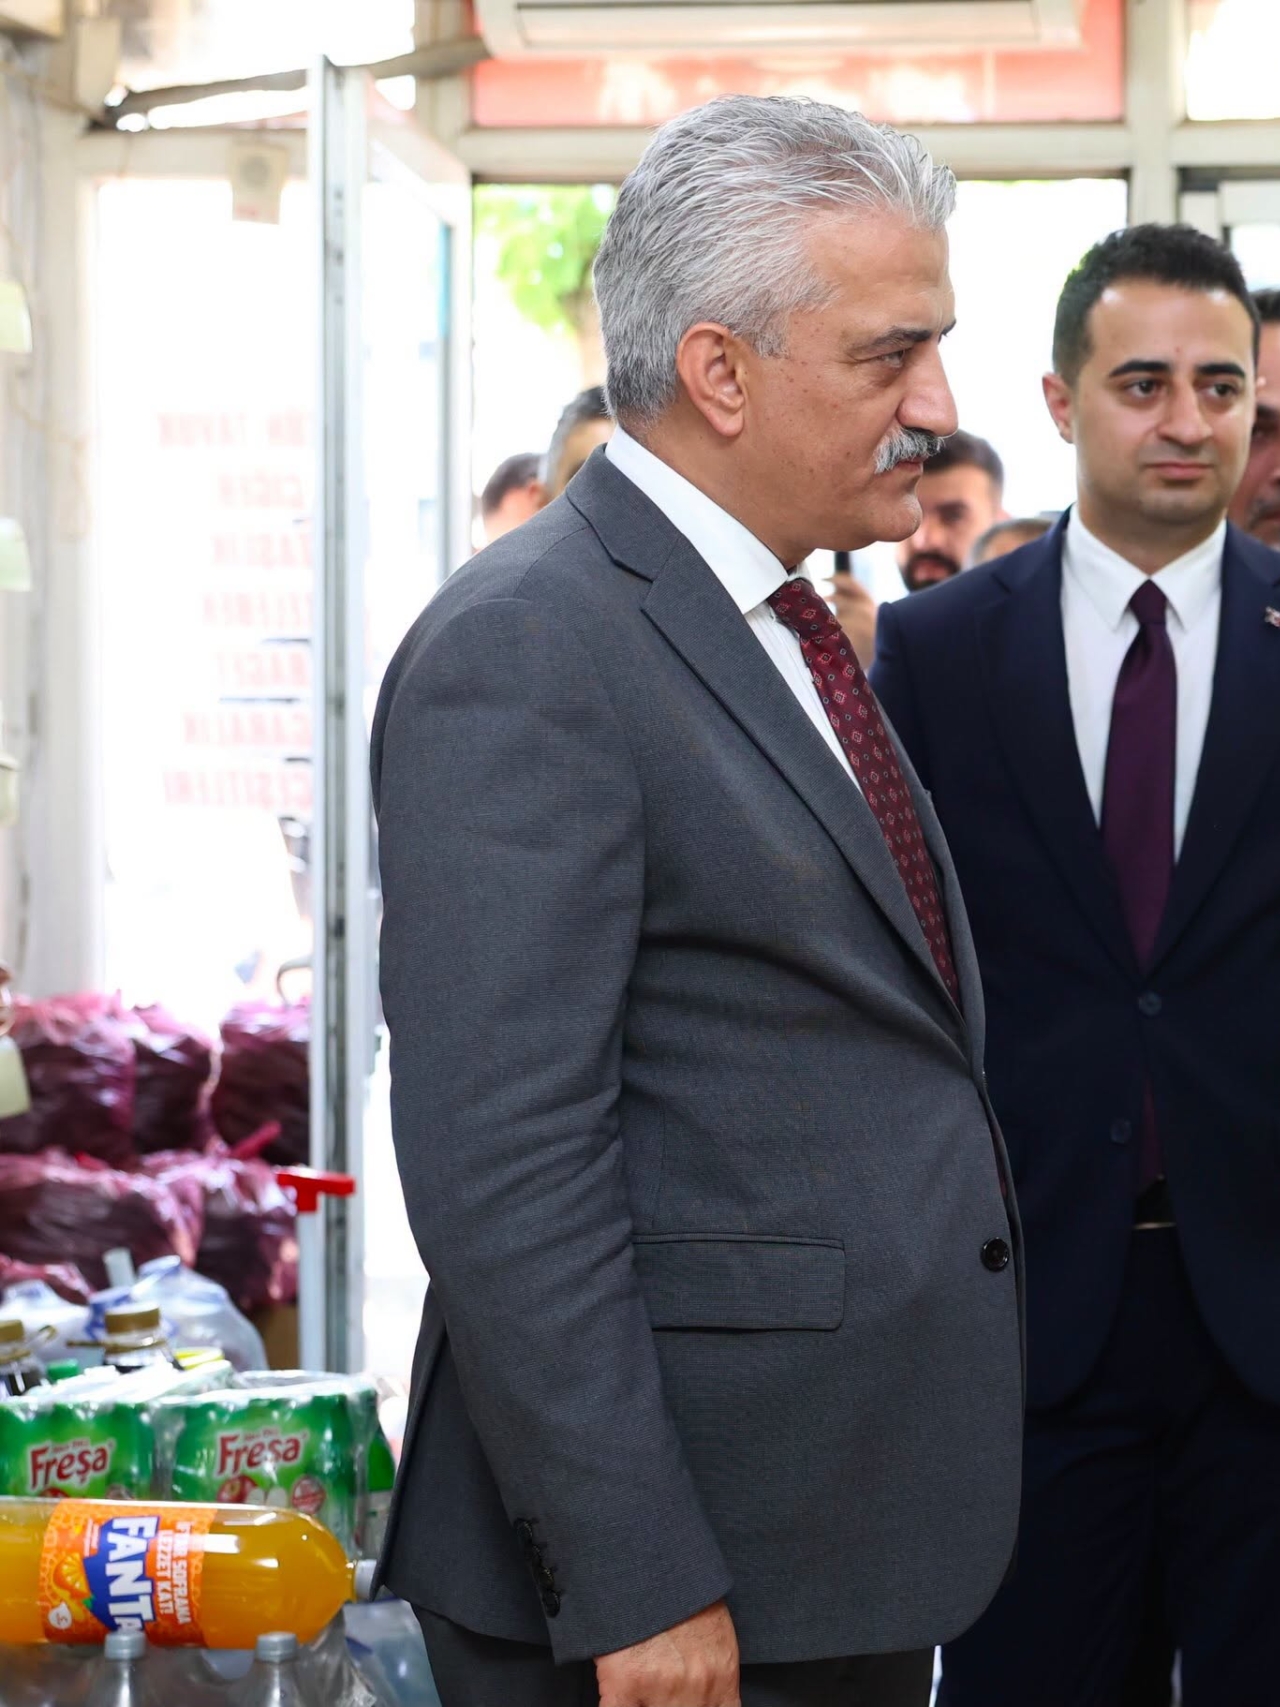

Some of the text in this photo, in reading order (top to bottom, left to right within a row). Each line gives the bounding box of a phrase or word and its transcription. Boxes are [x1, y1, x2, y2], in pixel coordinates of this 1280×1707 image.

[30, 1445, 109, 1491] Freşa
[105, 1515, 159, 1633] FANTA
[156, 1529, 174, 1578] LEZZET
[172, 1559, 191, 1624] SOFRANA
